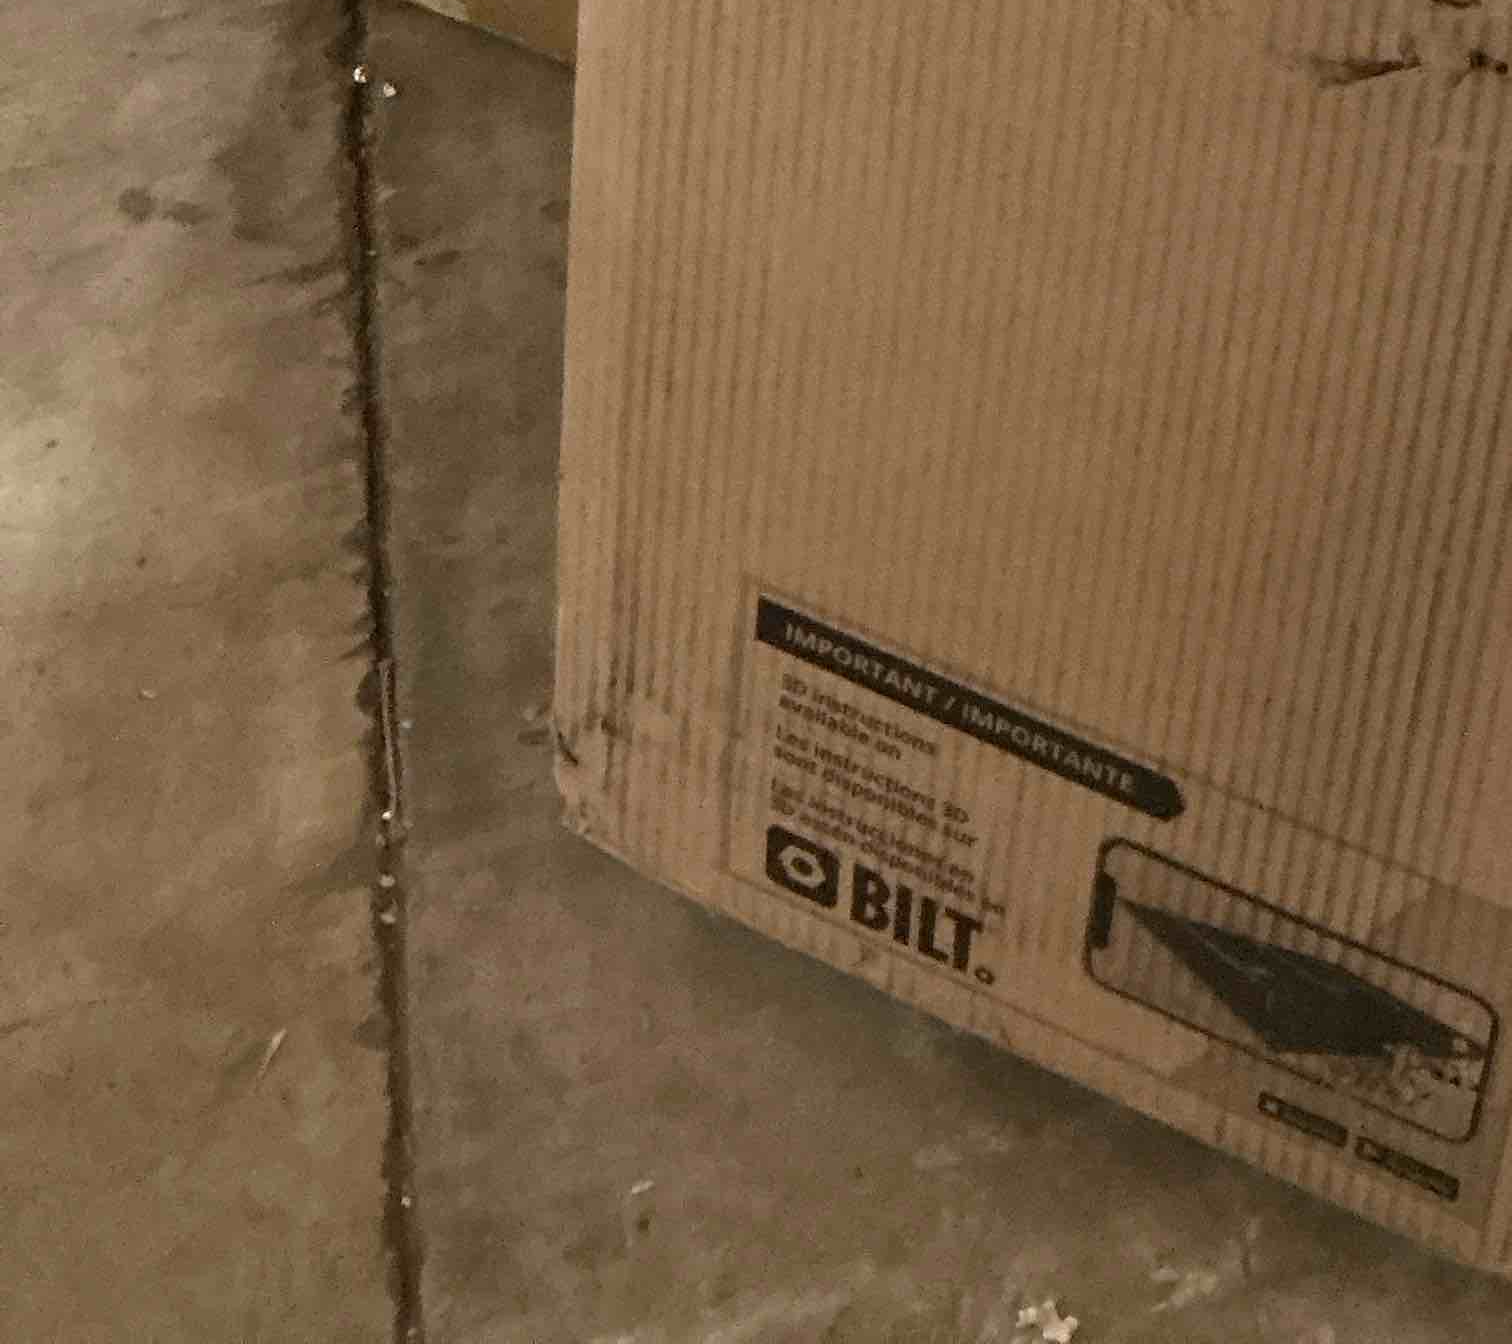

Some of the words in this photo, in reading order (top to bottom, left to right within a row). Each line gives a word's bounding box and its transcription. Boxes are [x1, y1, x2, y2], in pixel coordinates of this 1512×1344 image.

[784, 621, 940, 708] IMPORTANT
[961, 702, 1137, 793] IMPORTANTE
[849, 863, 983, 972] BILT
